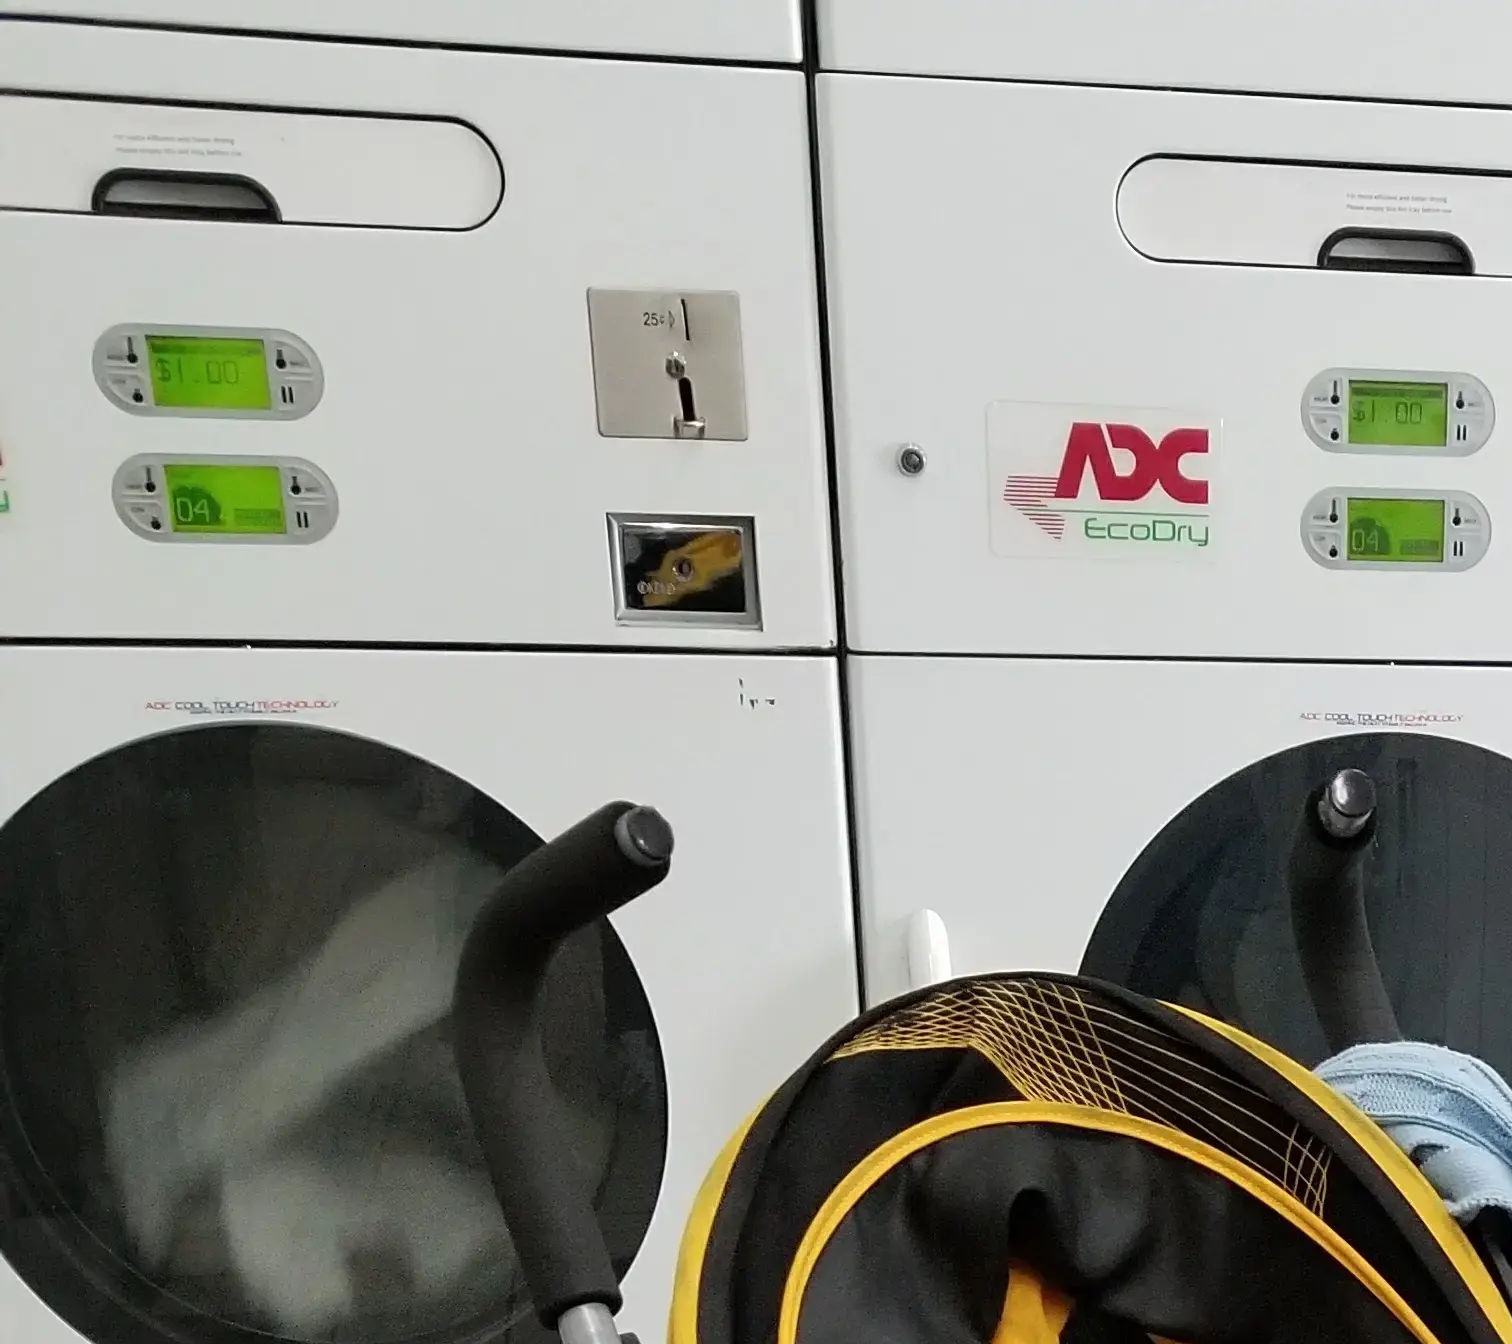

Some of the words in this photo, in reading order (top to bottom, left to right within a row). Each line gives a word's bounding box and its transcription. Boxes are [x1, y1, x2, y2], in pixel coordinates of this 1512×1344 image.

[1054, 421, 1209, 505] ADC
[1084, 517, 1210, 547] EcoDry
[174, 701, 210, 711] COOL
[212, 700, 255, 711] TOUCH
[256, 700, 340, 709] TECHNOLOGY
